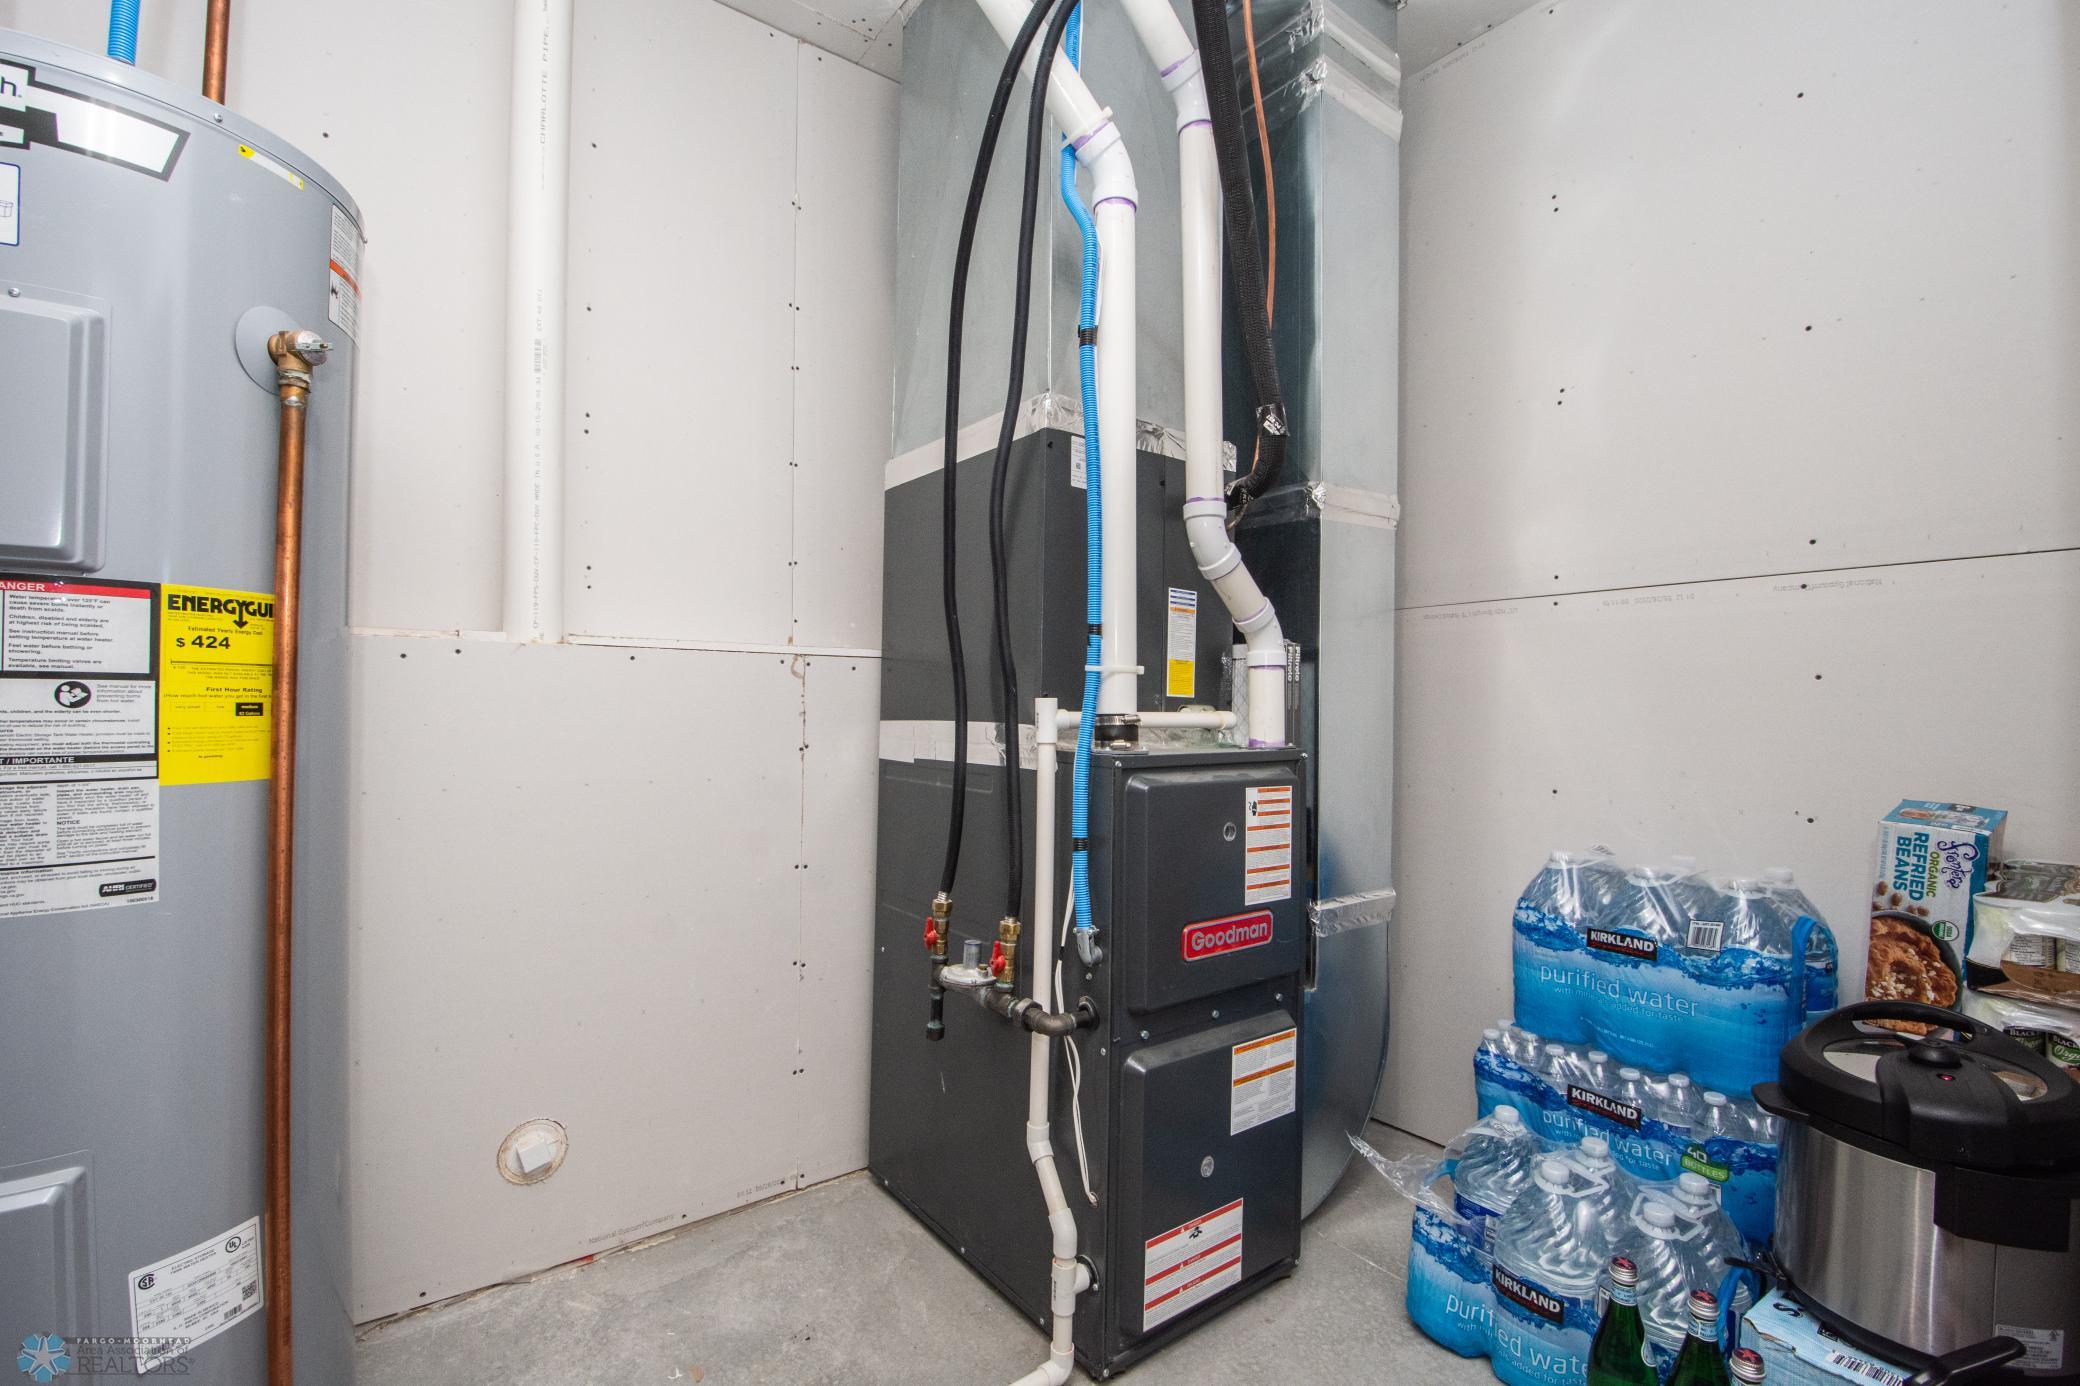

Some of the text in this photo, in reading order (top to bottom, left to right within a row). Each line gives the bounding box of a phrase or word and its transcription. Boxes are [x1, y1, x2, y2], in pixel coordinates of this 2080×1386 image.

[540, 72, 548, 144] CHARLOTTE
[0, 582, 45, 591] ANGER
[168, 594, 273, 624] ENERGYGUI
[176, 635, 230, 649] $ 424
[1892, 836, 1912, 891] BEANS
[1909, 831, 1929, 901] REFRIED
[1926, 851, 1940, 898] ORGANIC
[1192, 922, 1268, 951] Goodman
[1590, 931, 1655, 952] KIRKLAND
[1540, 965, 1700, 1017] purified water
[1572, 1088, 1637, 1120] KIRKLAND
[1614, 1133, 1672, 1165] water
[1684, 1158, 1725, 1179] BOTTLES
[1495, 1268, 1560, 1313] KIRKLAND
